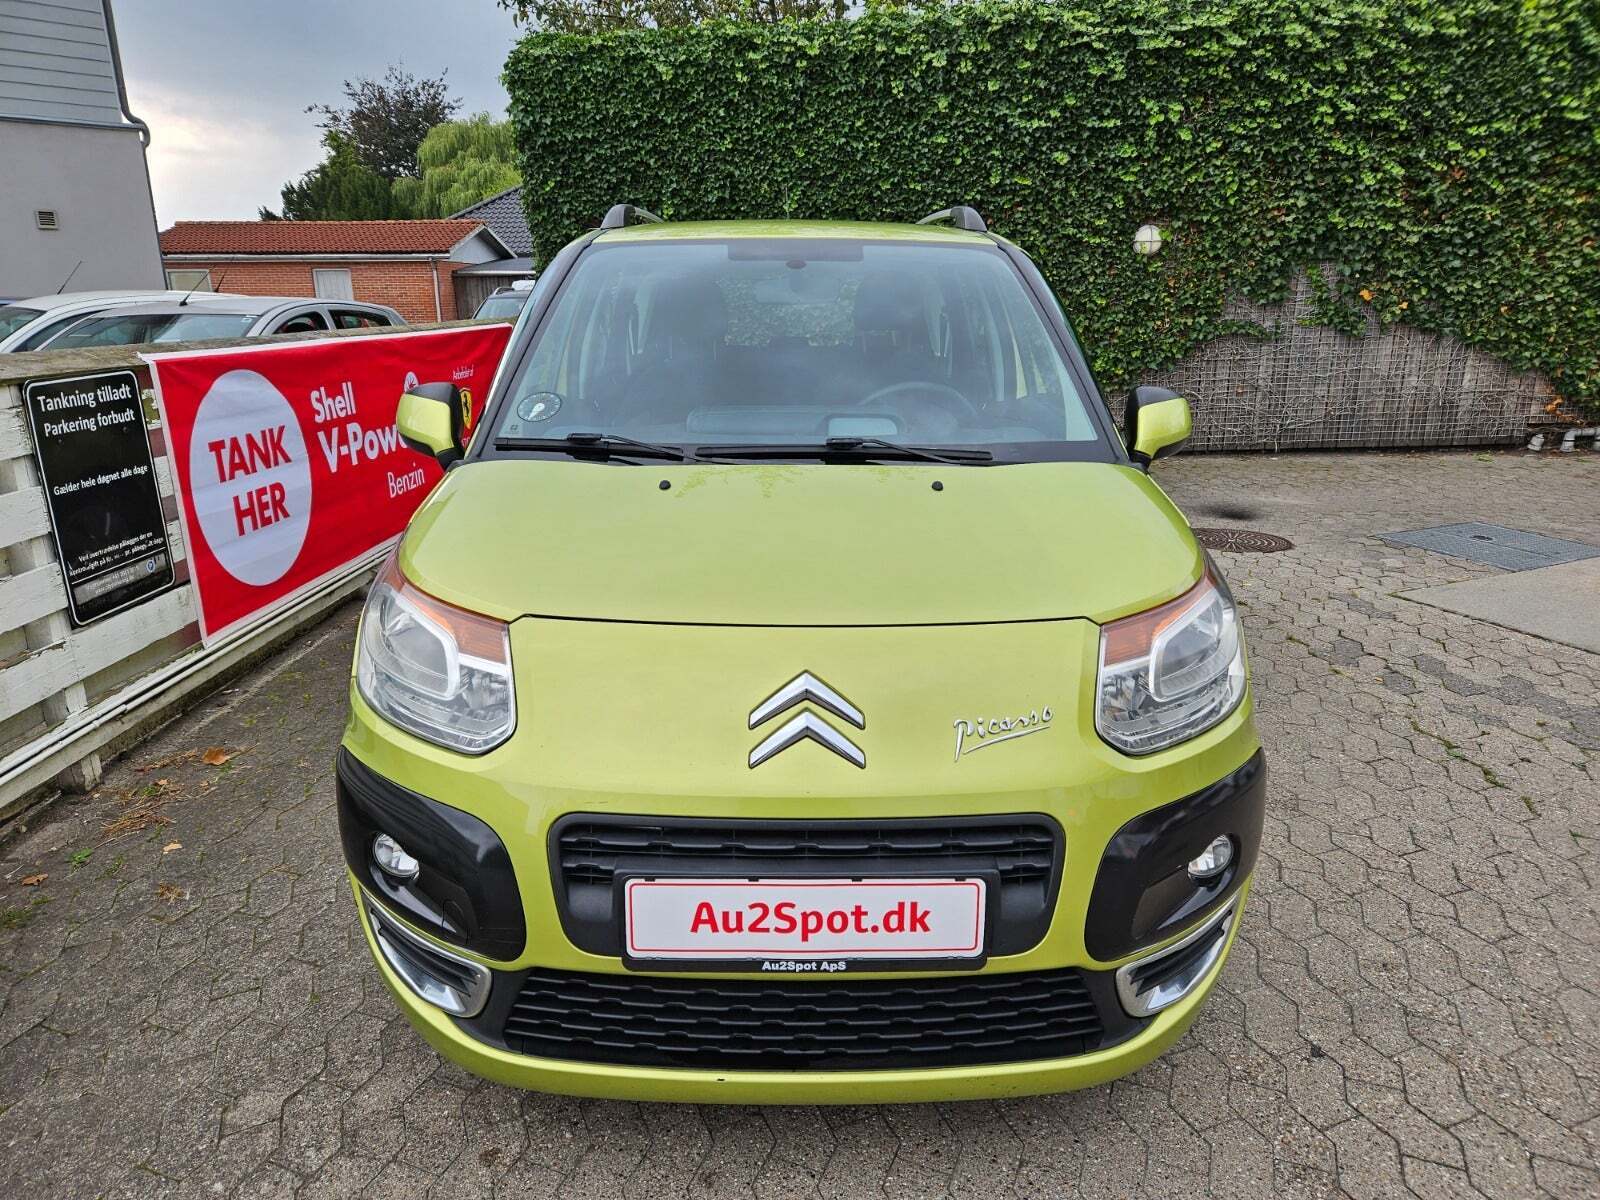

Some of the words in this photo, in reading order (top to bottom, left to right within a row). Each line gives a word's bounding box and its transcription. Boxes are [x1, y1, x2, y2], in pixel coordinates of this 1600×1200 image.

[37, 391, 96, 413] Tankning
[96, 383, 132, 403] tilladt
[310, 381, 356, 423] Shell
[43, 416, 97, 437] Parkering
[97, 407, 136, 427] forbudt
[208, 424, 293, 484] TANK
[53, 482, 81, 496] Gælder
[80, 477, 97, 490] hele
[96, 471, 121, 485] døgnet
[120, 467, 133, 478] alle
[133, 464, 149, 476] dage
[387, 461, 425, 498] Benzin
[233, 481, 290, 536] HER
[953, 704, 1053, 762] Picasso
[690, 900, 932, 942] Au2Spot.dk
[761, 960, 817, 973] Au2Spot
[820, 960, 847, 972] ApS
